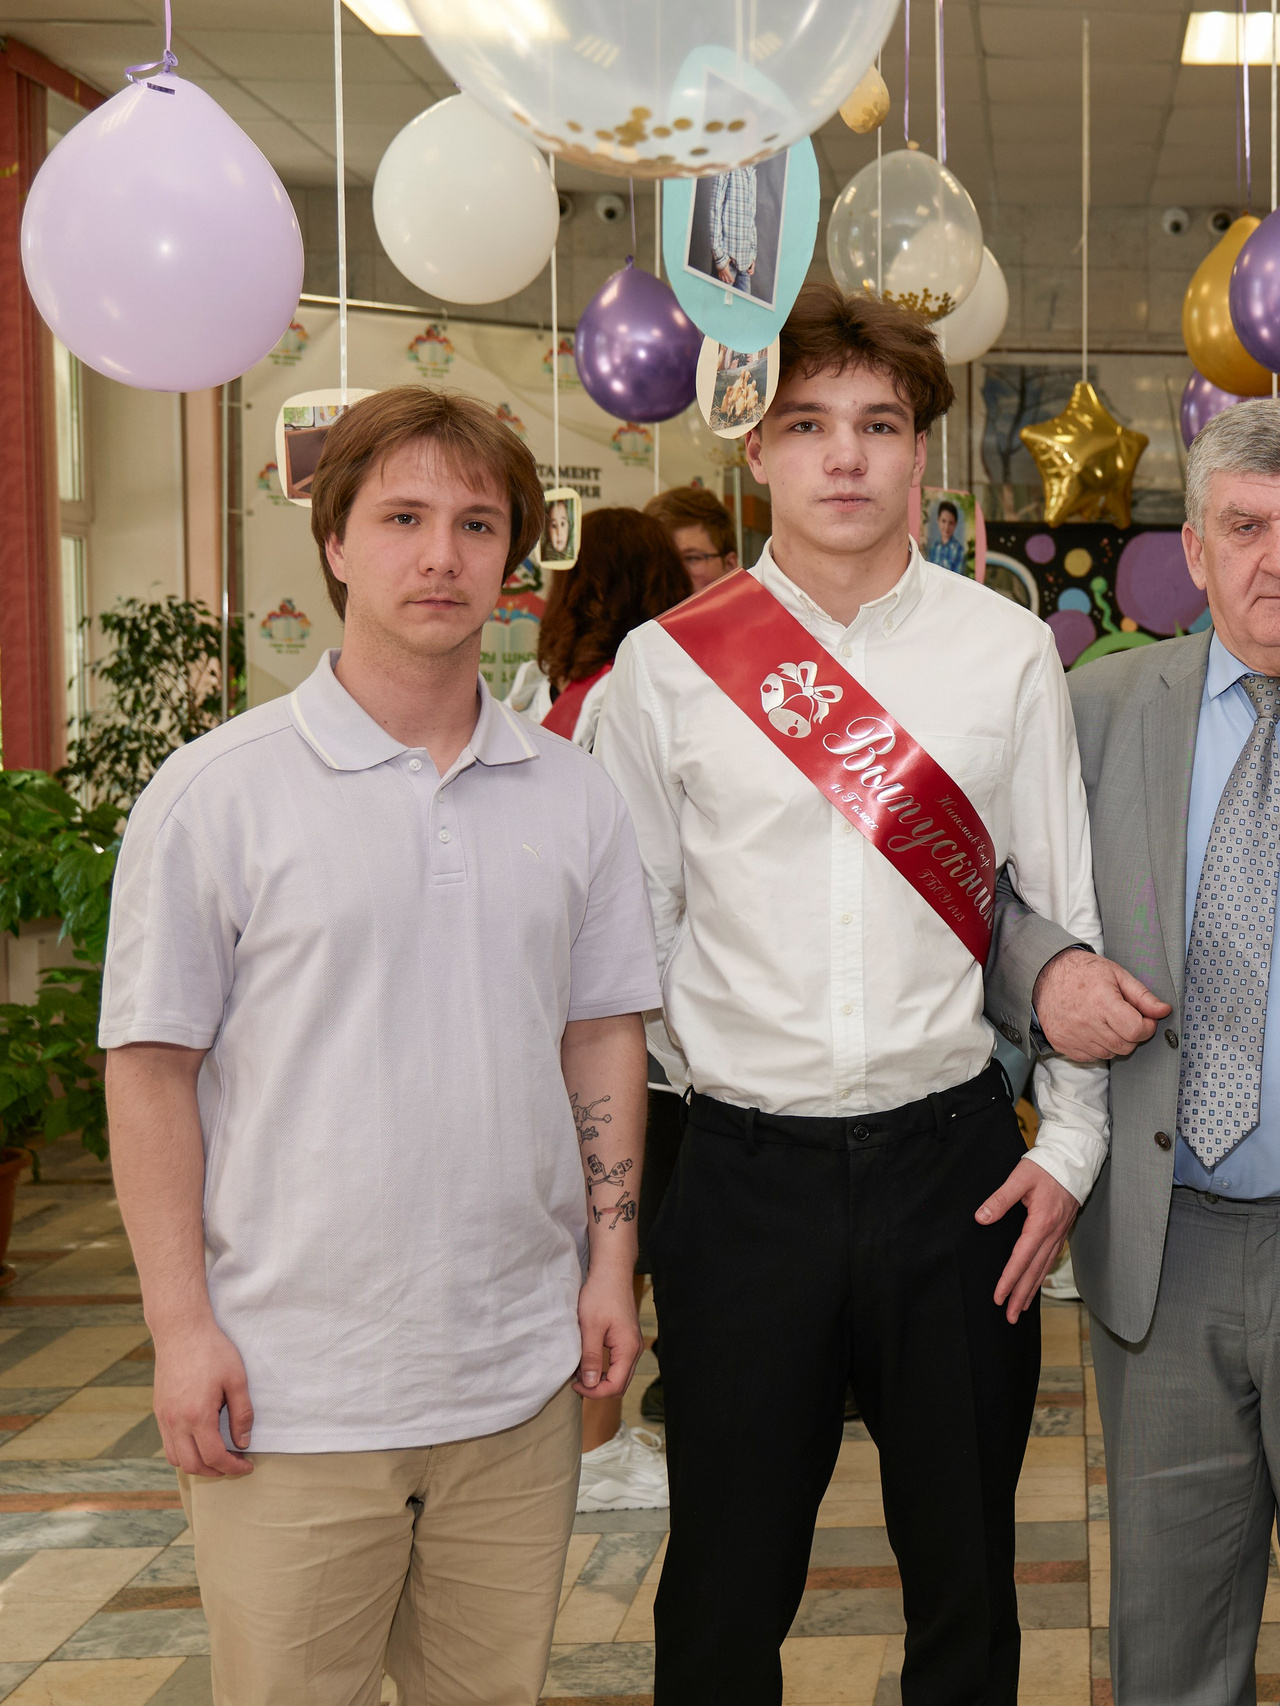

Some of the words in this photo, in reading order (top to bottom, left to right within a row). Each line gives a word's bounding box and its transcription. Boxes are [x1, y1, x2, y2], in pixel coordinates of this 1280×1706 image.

[536, 464, 602, 481] ТАМЕНТ
[830, 783, 845, 794] 11
[841, 792, 863, 803] Г
[851, 805, 879, 831] класс
[976, 840, 991, 868] Егор
[917, 868, 954, 904] ГБОУ
